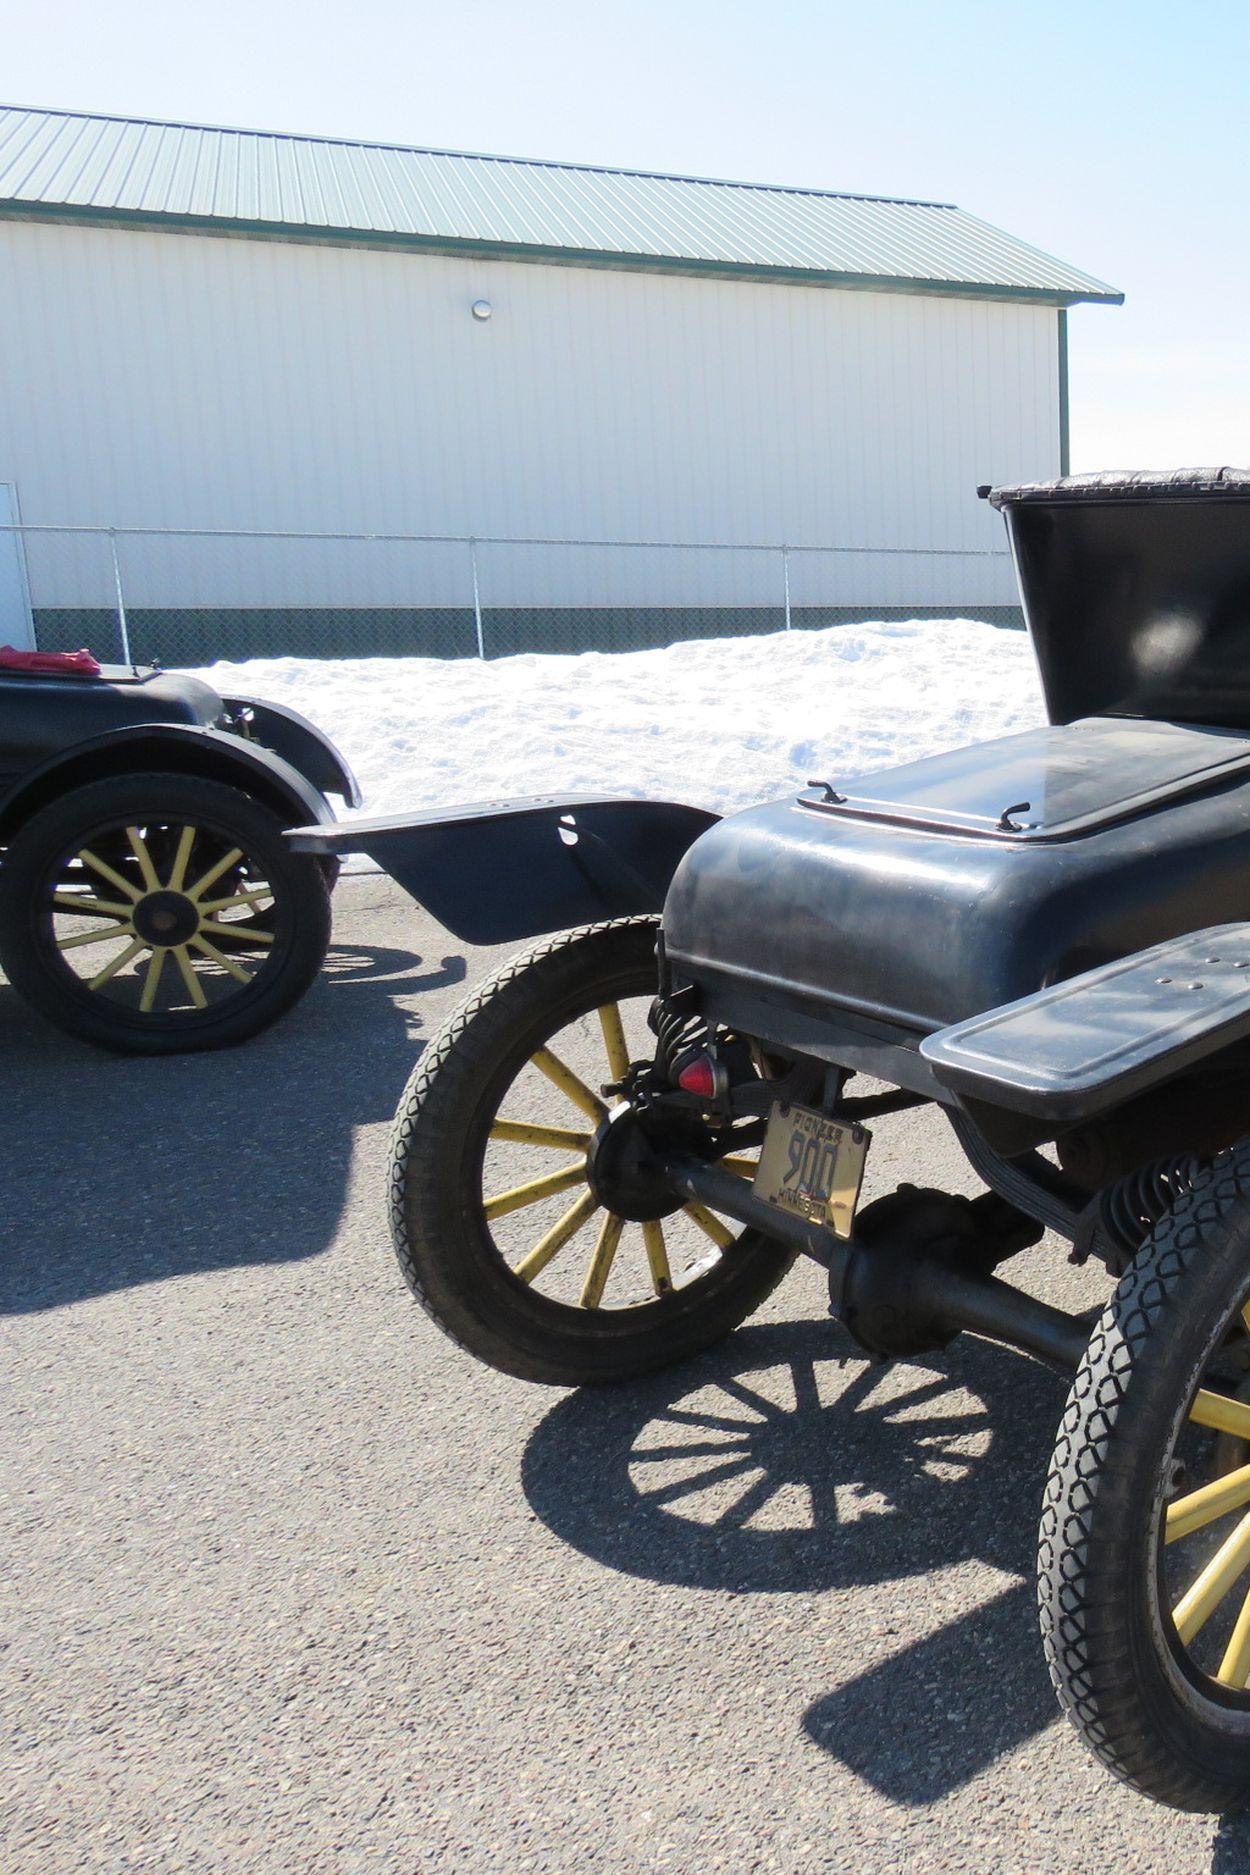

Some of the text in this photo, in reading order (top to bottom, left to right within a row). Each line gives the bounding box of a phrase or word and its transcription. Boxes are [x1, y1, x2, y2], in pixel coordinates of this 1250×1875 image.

[793, 1112, 844, 1141] PIONEER
[783, 1129, 839, 1201] 900
[778, 1187, 828, 1218] MINNESOTA
